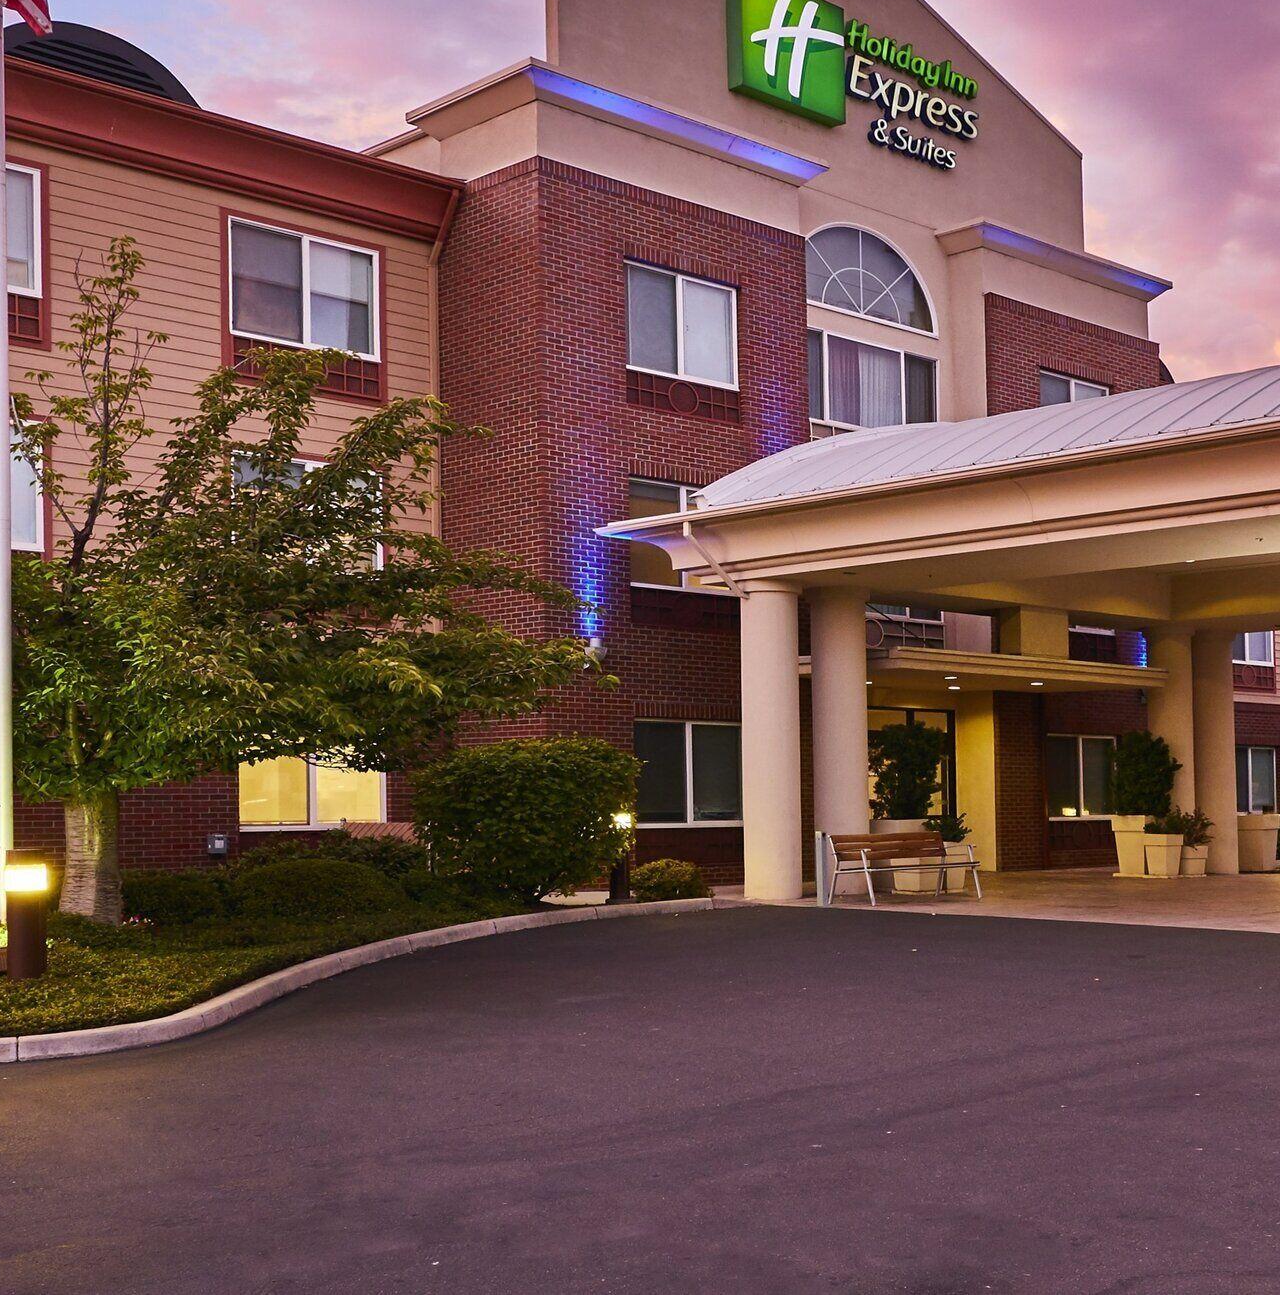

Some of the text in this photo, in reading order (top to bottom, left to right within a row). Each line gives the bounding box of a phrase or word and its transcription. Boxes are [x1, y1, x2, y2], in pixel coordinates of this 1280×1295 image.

[846, 19, 978, 98] Holiday Inn
[849, 54, 979, 140] Express
[873, 118, 957, 170] & Suites
